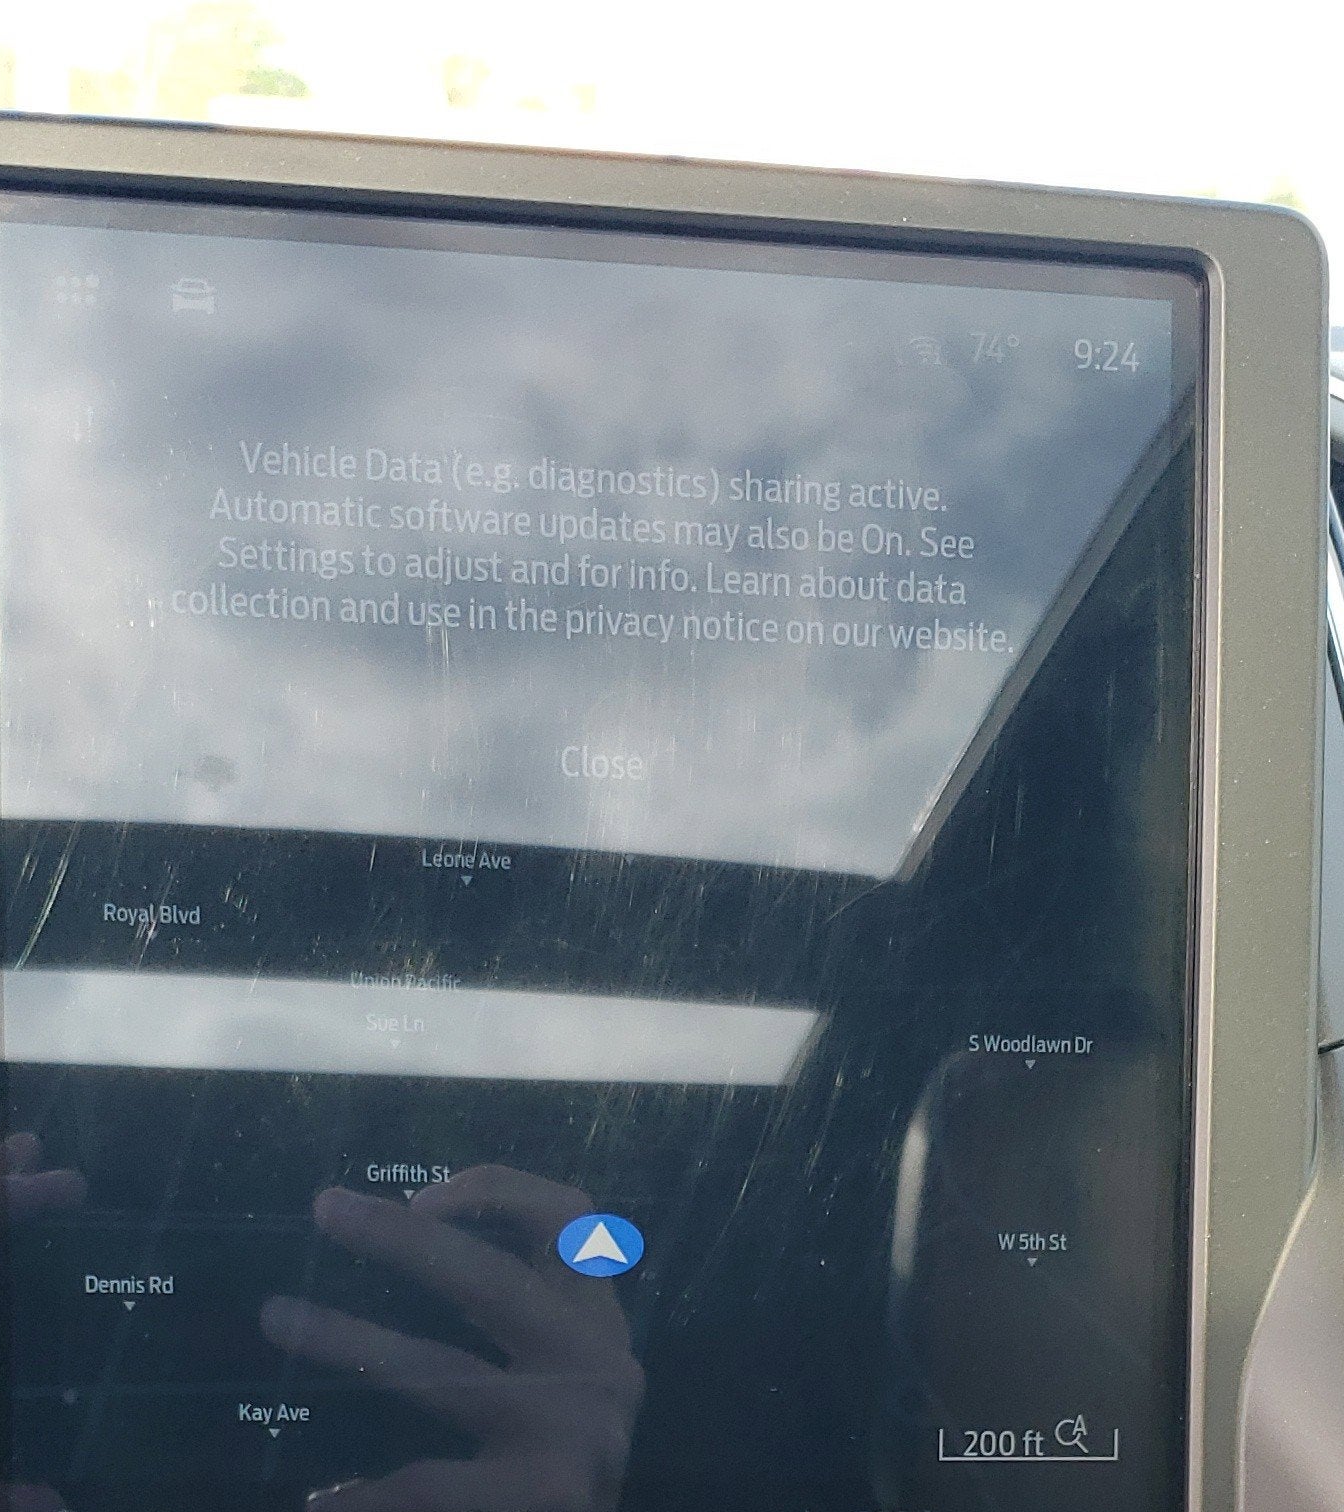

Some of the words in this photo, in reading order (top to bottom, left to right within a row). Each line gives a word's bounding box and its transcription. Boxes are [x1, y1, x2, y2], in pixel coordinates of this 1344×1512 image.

[1074, 338, 1140, 373] 9:24
[239, 440, 357, 480] Vehicle
[366, 449, 443, 483] Data
[452, 450, 519, 494] (e.g.
[528, 455, 720, 506] diagnostics)
[728, 469, 841, 512] sharing
[849, 479, 947, 511] active.
[209, 486, 382, 528] Automatic
[389, 497, 531, 537] software
[539, 506, 667, 544] updates
[674, 519, 740, 553] may
[747, 517, 809, 550] also
[818, 519, 854, 553] be
[861, 523, 911, 556] On.
[920, 526, 975, 559] See
[218, 536, 354, 580] Settings
[361, 545, 396, 576] to
[405, 547, 503, 586] adjust
[511, 553, 569, 586] and
[579, 554, 622, 588] for
[630, 559, 698, 592] info.
[707, 561, 791, 597] Learn
[798, 567, 890, 601] about
[897, 570, 967, 605] data
[172, 582, 331, 620] collection
[340, 592, 399, 624] and
[409, 601, 461, 628] use
[469, 598, 497, 631] in
[505, 598, 557, 633] the
[566, 603, 675, 644] privacy
[682, 610, 779, 644] notice
[786, 619, 824, 645] on
[832, 621, 882, 647] our
[889, 619, 1014, 653] website.
[560, 745, 643, 782] Close
[421, 849, 474, 870] Leone
[478, 851, 512, 871] Ave
[103, 903, 156, 927] Royal
[159, 904, 201, 926] Blvd
[968, 1034, 980, 1053] S
[983, 1034, 1072, 1054] Woodlawn
[1074, 1035, 1094, 1055] Dr
[366, 1164, 425, 1184] Griffith
[429, 1165, 451, 1184] St
[997, 1233, 1015, 1252] W
[1018, 1232, 1046, 1252] 5th
[1048, 1233, 1068, 1252] St
[84, 1275, 145, 1295] Dennis
[149, 1275, 175, 1295] Rd
[238, 1403, 274, 1425] Kay
[276, 1403, 311, 1422] Ave
[962, 1430, 1015, 1457] 200
[1021, 1429, 1045, 1457] ft
